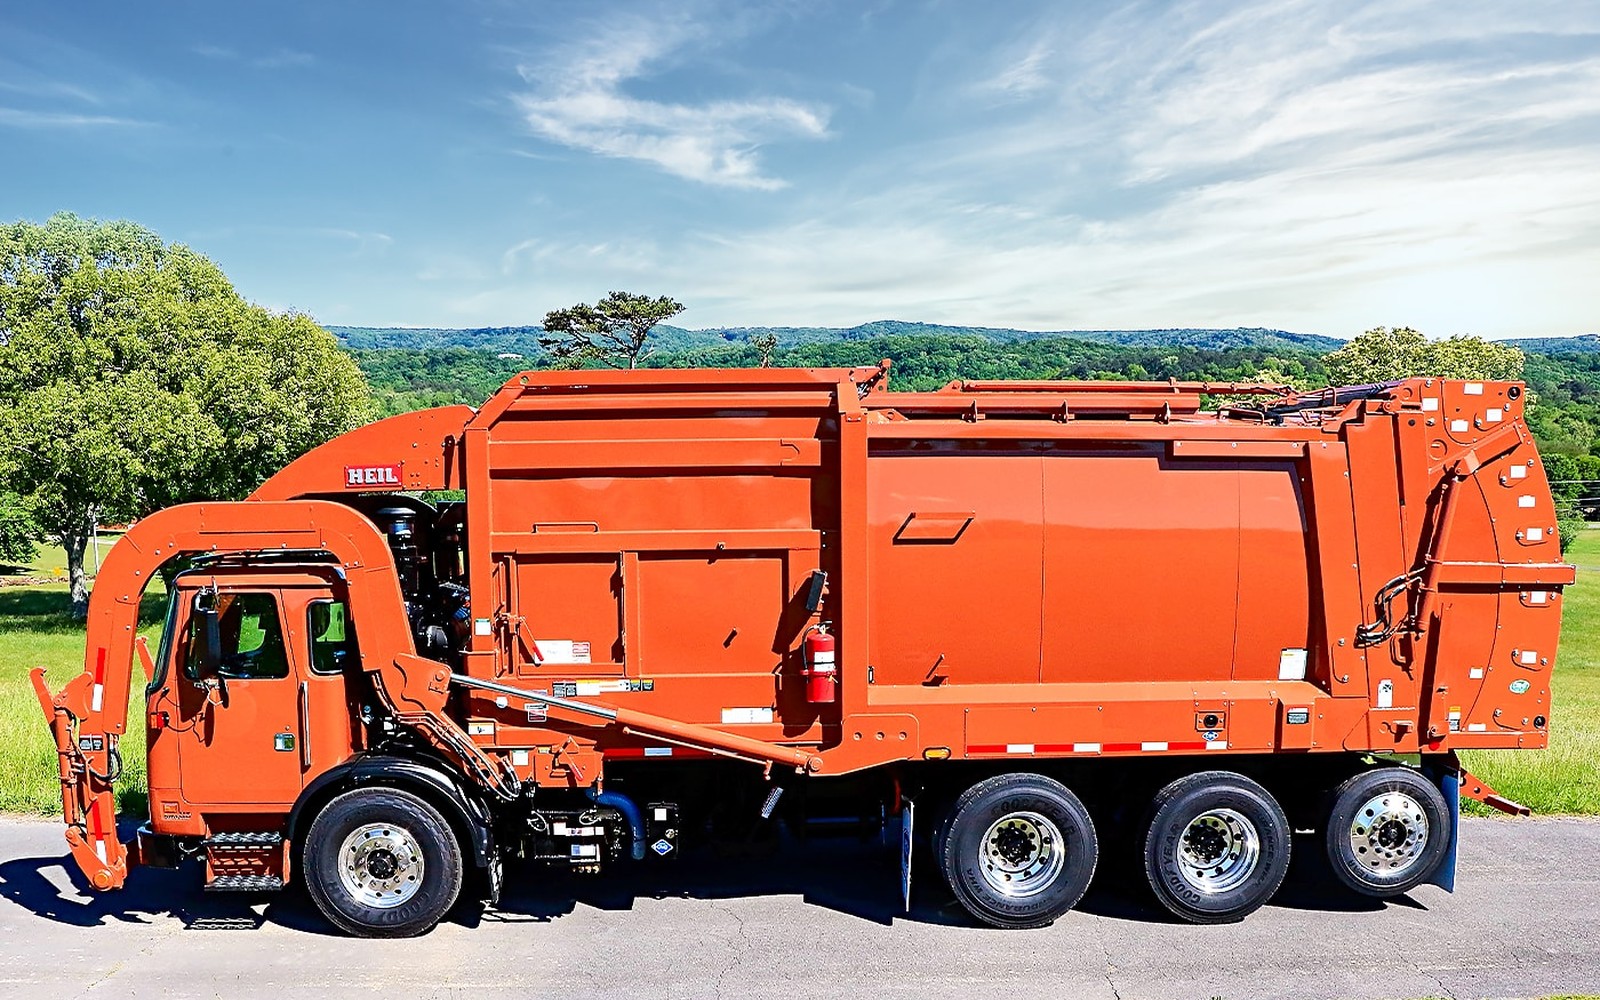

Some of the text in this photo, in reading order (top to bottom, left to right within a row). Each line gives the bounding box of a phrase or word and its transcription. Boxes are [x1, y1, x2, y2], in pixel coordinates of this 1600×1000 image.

[348, 467, 399, 484] HEIL
[990, 797, 1077, 836] GOODYEAR
[1162, 823, 1201, 904] GOODYEAR
